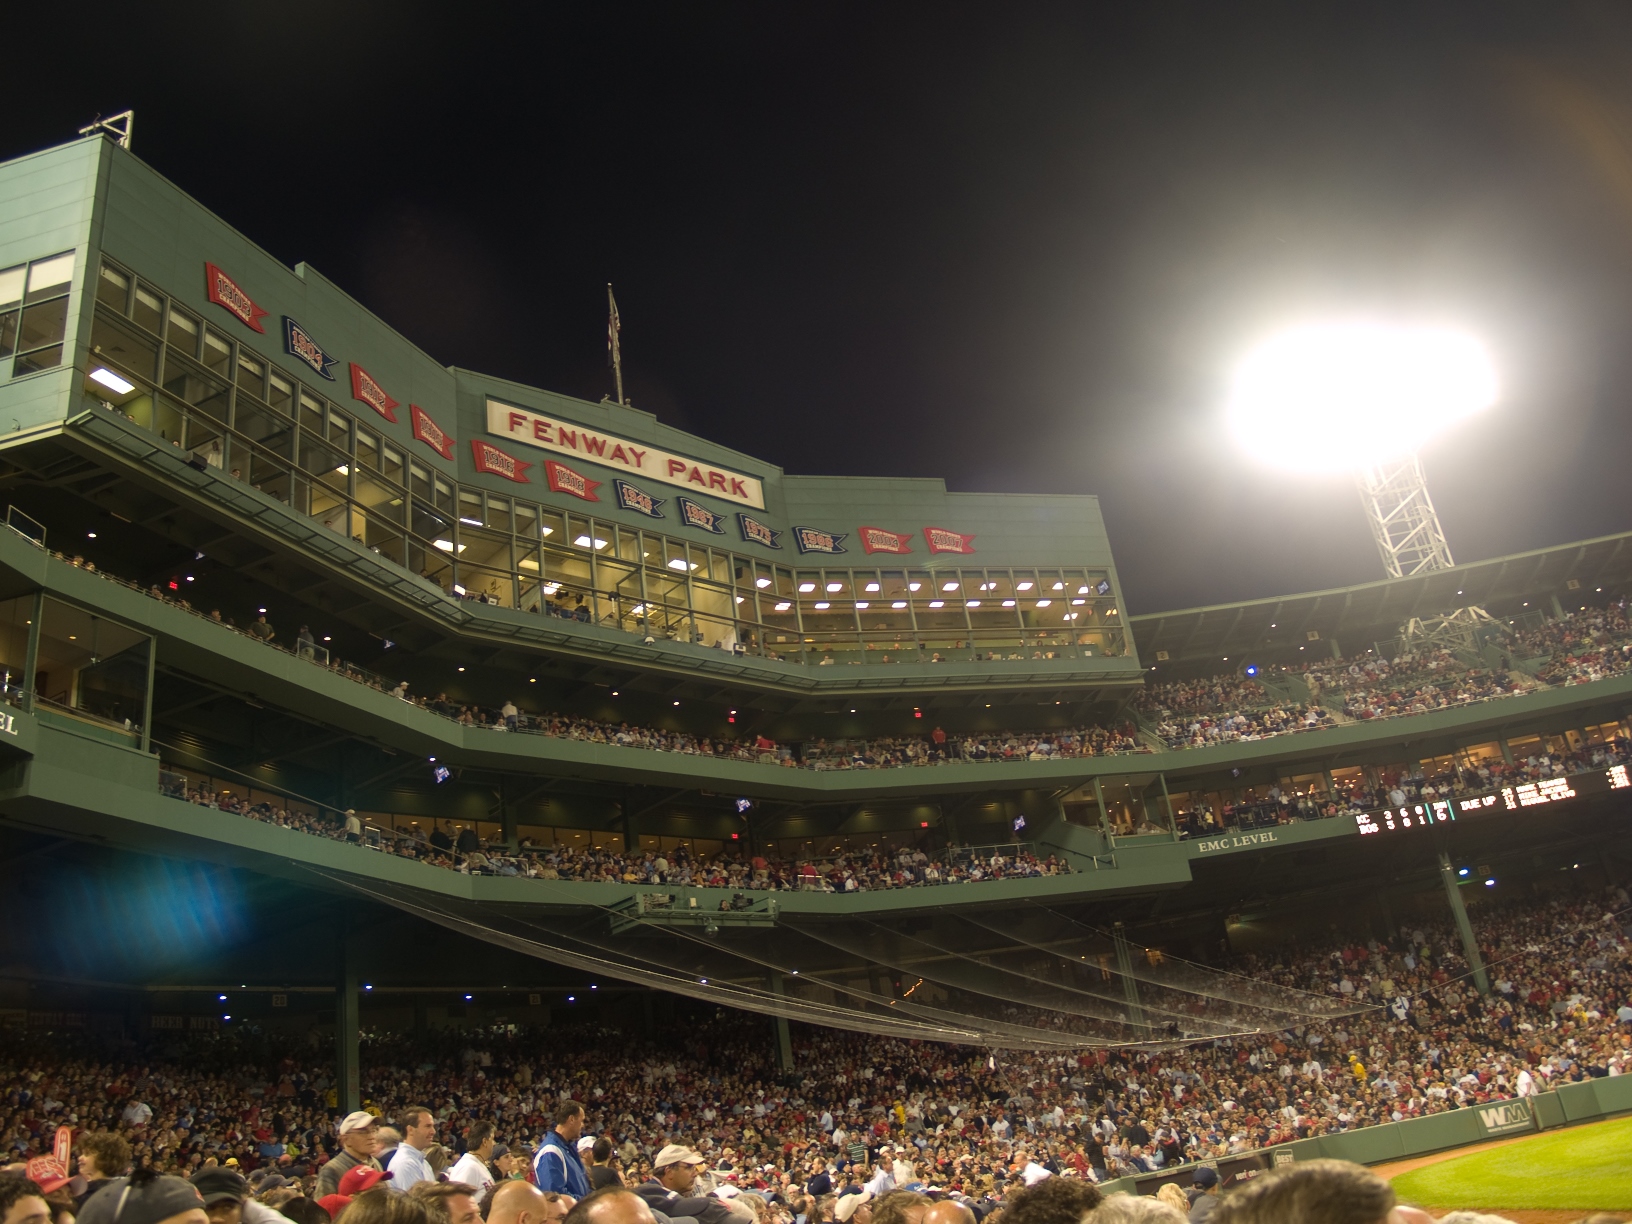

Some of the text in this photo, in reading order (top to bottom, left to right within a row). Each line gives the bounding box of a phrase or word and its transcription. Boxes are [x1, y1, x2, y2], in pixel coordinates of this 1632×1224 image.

[217, 279, 252, 317] 1903
[484, 450, 515, 473] 1916
[508, 412, 748, 498] FENWAY PARK
[556, 470, 586, 492] 1918
[622, 488, 653, 511] 1946
[686, 506, 714, 526] 1967
[745, 521, 772, 542] 1975
[867, 533, 900, 548] 2004
[931, 533, 964, 548] 2007
[1460, 796, 1496, 810] DUE UP
[1356, 814, 1370, 824] KC
[1383, 810, 1392, 820] 3
[1400, 808, 1408, 817] 6
[1359, 815, 1425, 834] BOS 5 8 1
[1198, 832, 1277, 852] EMC LEVEL
[274, 996, 285, 1005] 20
[151, 1015, 220, 1029] BEER NUTS
[1479, 1103, 1530, 1128] WM
[1276, 1154, 1293, 1163] BEST
[1235, 1169, 1256, 1180] verizon
